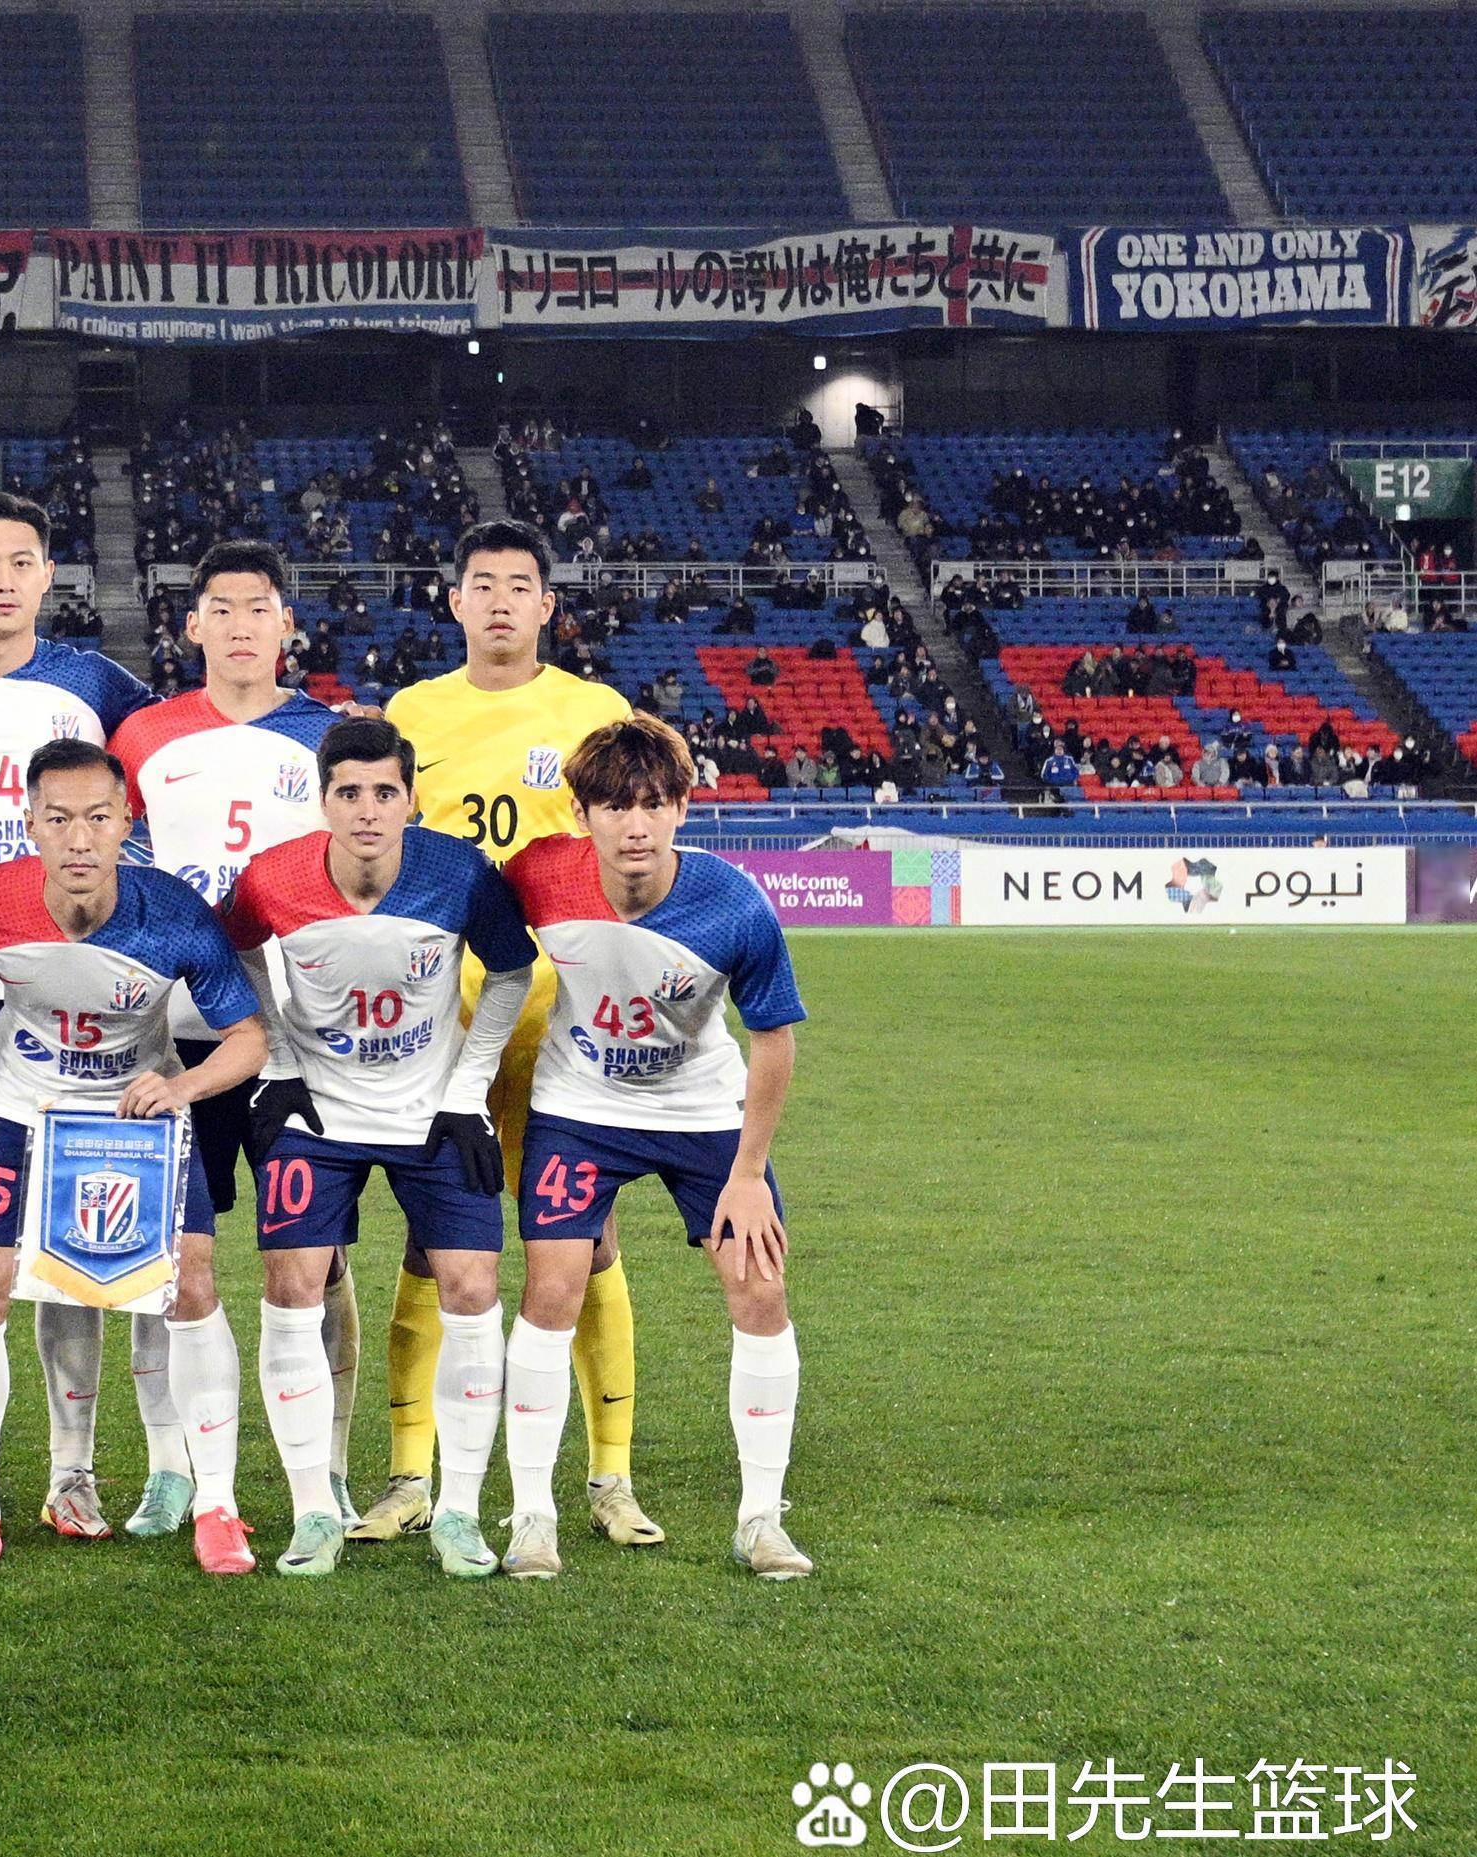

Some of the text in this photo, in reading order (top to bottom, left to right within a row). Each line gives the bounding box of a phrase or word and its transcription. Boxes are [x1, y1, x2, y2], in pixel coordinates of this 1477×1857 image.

[1117, 229, 1362, 267] ONE AND ONLY
[57, 234, 479, 305] PAINT IT TRICOLORE
[500, 232, 1040, 315] トリコロールの誇りは俺たちと共に
[1112, 264, 1371, 319] YOKOHAMA
[141, 320, 216, 343] anymore
[1376, 464, 1430, 498] E12
[225, 800, 252, 852] 5
[462, 794, 518, 847] 30
[763, 873, 849, 890] Welcome
[779, 889, 863, 907] to Arabia
[1003, 870, 1143, 901] NEOM
[1245, 862, 1363, 907] نيوم
[349, 989, 403, 1028] 10
[592, 993, 655, 1039] 43
[51, 1009, 103, 1050] 15
[359, 1016, 434, 1053] SHANGHAI
[359, 1032, 433, 1064] PASS
[60, 1044, 139, 1070] SHANGHAI
[604, 1040, 686, 1065] SHANGHAI
[604, 1056, 684, 1078] PASS
[265, 1158, 313, 1215] 10
[535, 1154, 599, 1212] 43
